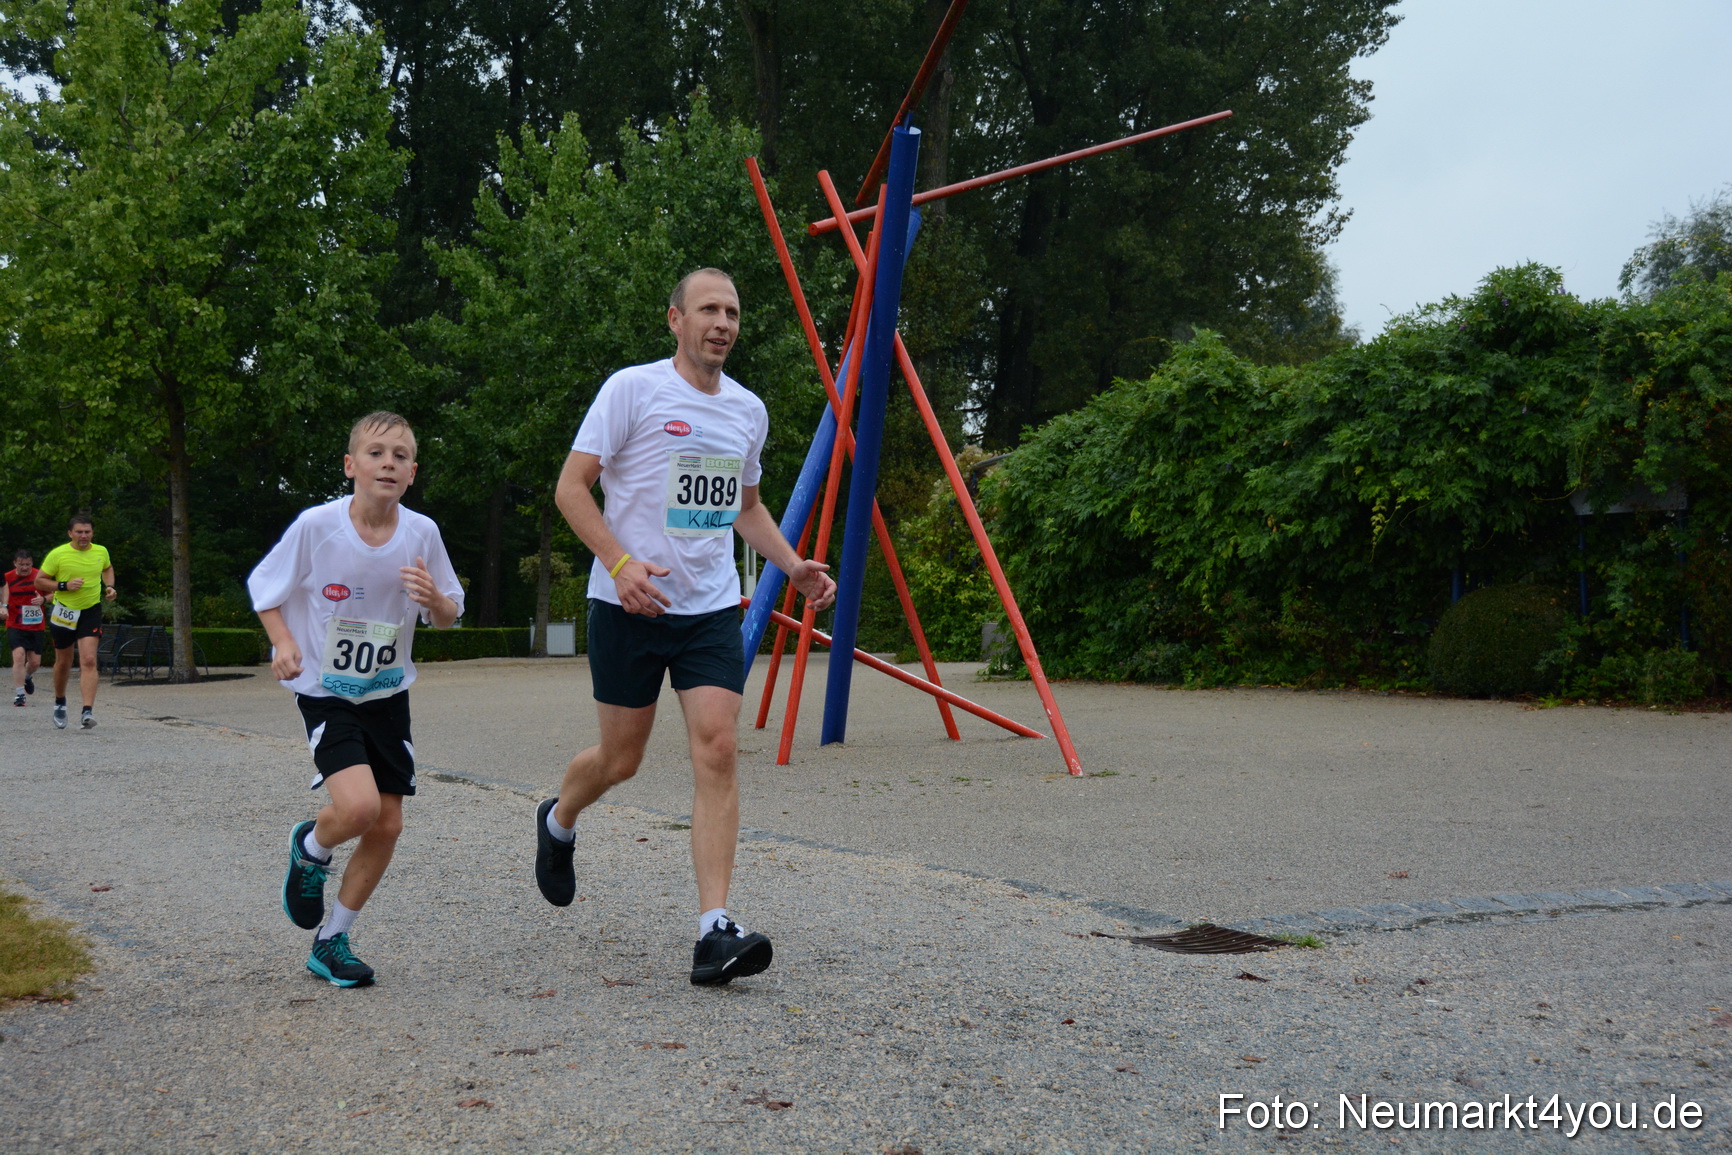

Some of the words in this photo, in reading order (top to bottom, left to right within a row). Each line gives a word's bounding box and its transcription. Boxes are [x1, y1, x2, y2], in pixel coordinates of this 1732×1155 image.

[667, 423, 690, 433] Hervis
[705, 458, 740, 469] BOCK
[677, 474, 737, 507] 3089
[688, 510, 734, 528] KARL
[325, 586, 349, 598] Hervis
[336, 626, 367, 635] NeuerMarkt
